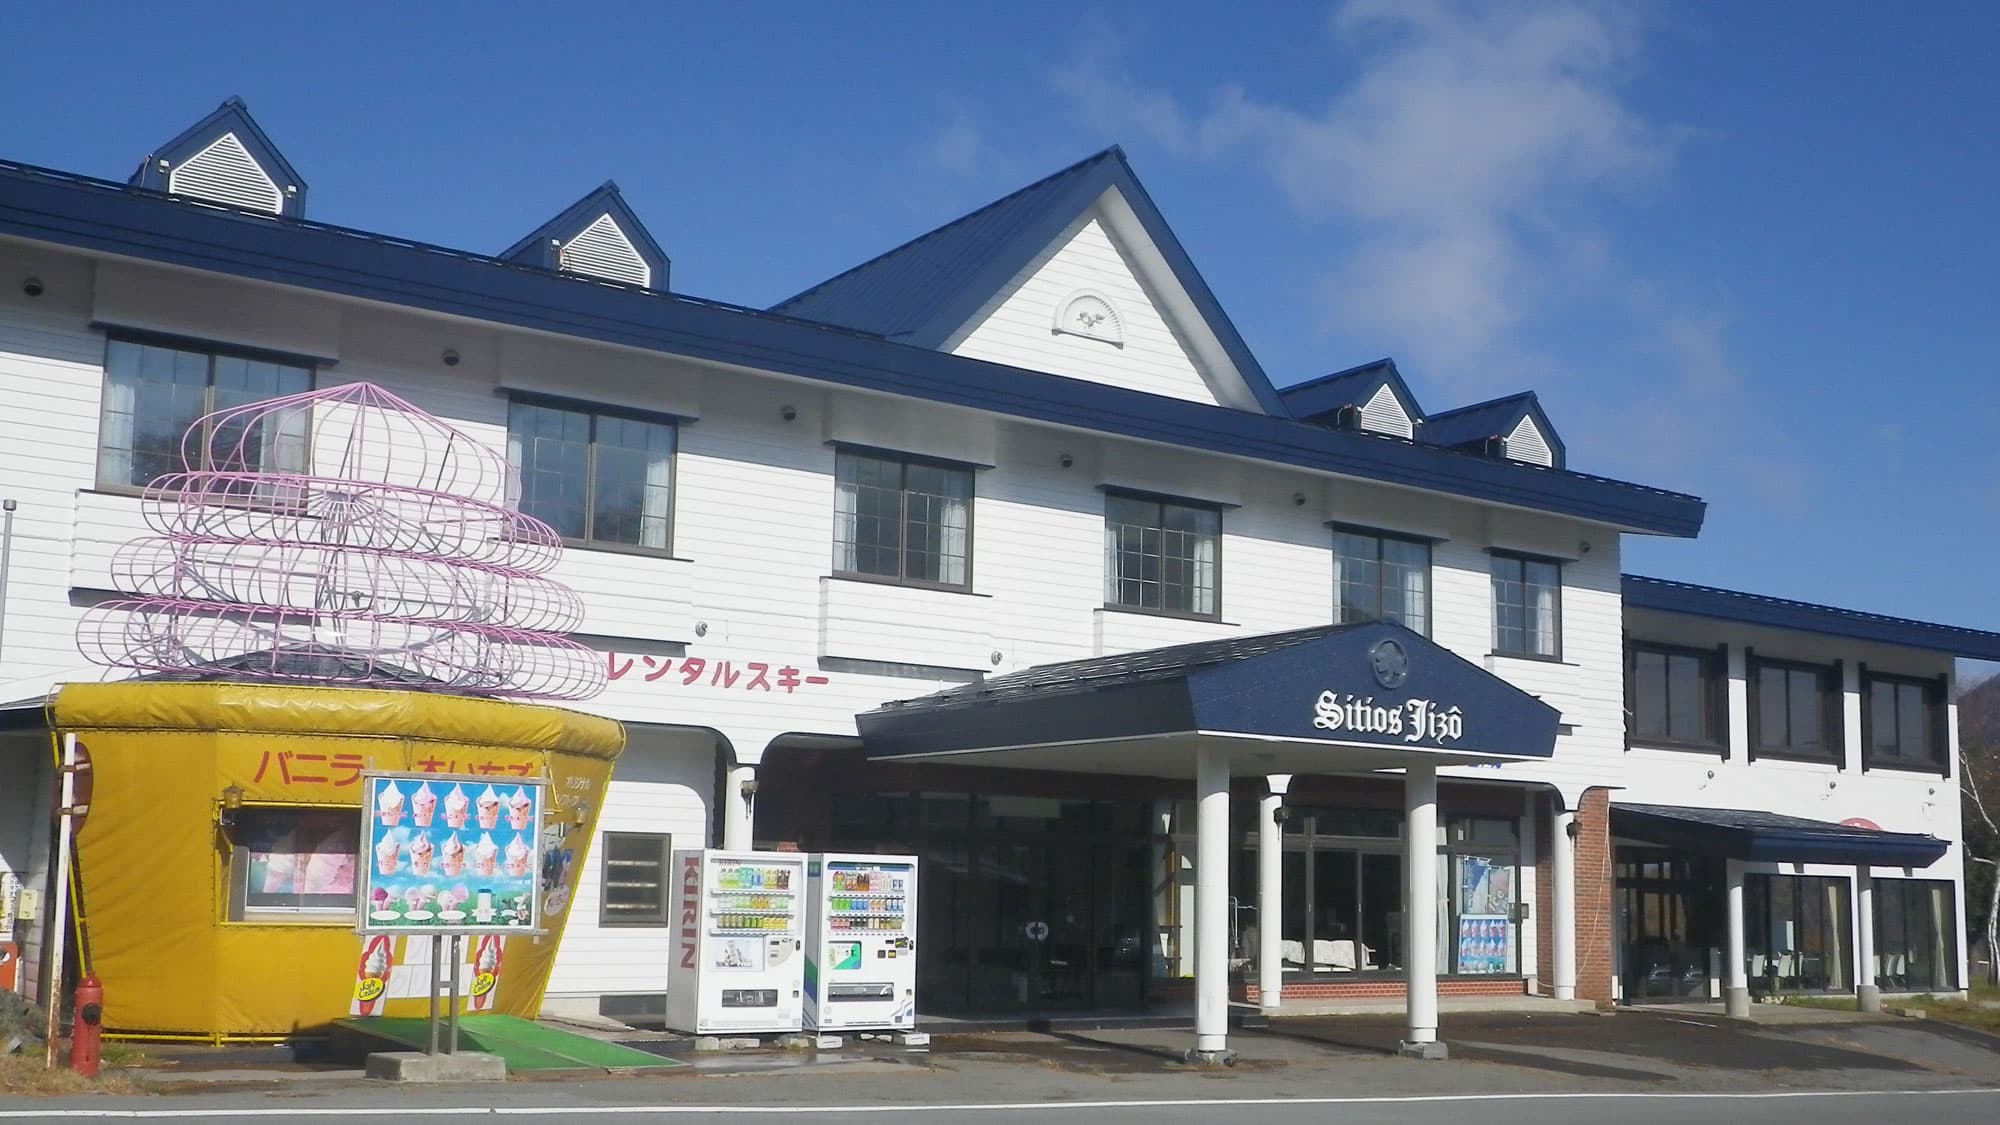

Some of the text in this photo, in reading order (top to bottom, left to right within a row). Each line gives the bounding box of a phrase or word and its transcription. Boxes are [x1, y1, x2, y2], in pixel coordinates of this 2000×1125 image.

[608, 651, 829, 694] レンタルスキー
[1313, 689, 1464, 745] Sitios Jizô
[254, 751, 365, 786] バニラ
[680, 857, 700, 969] KIRIN
